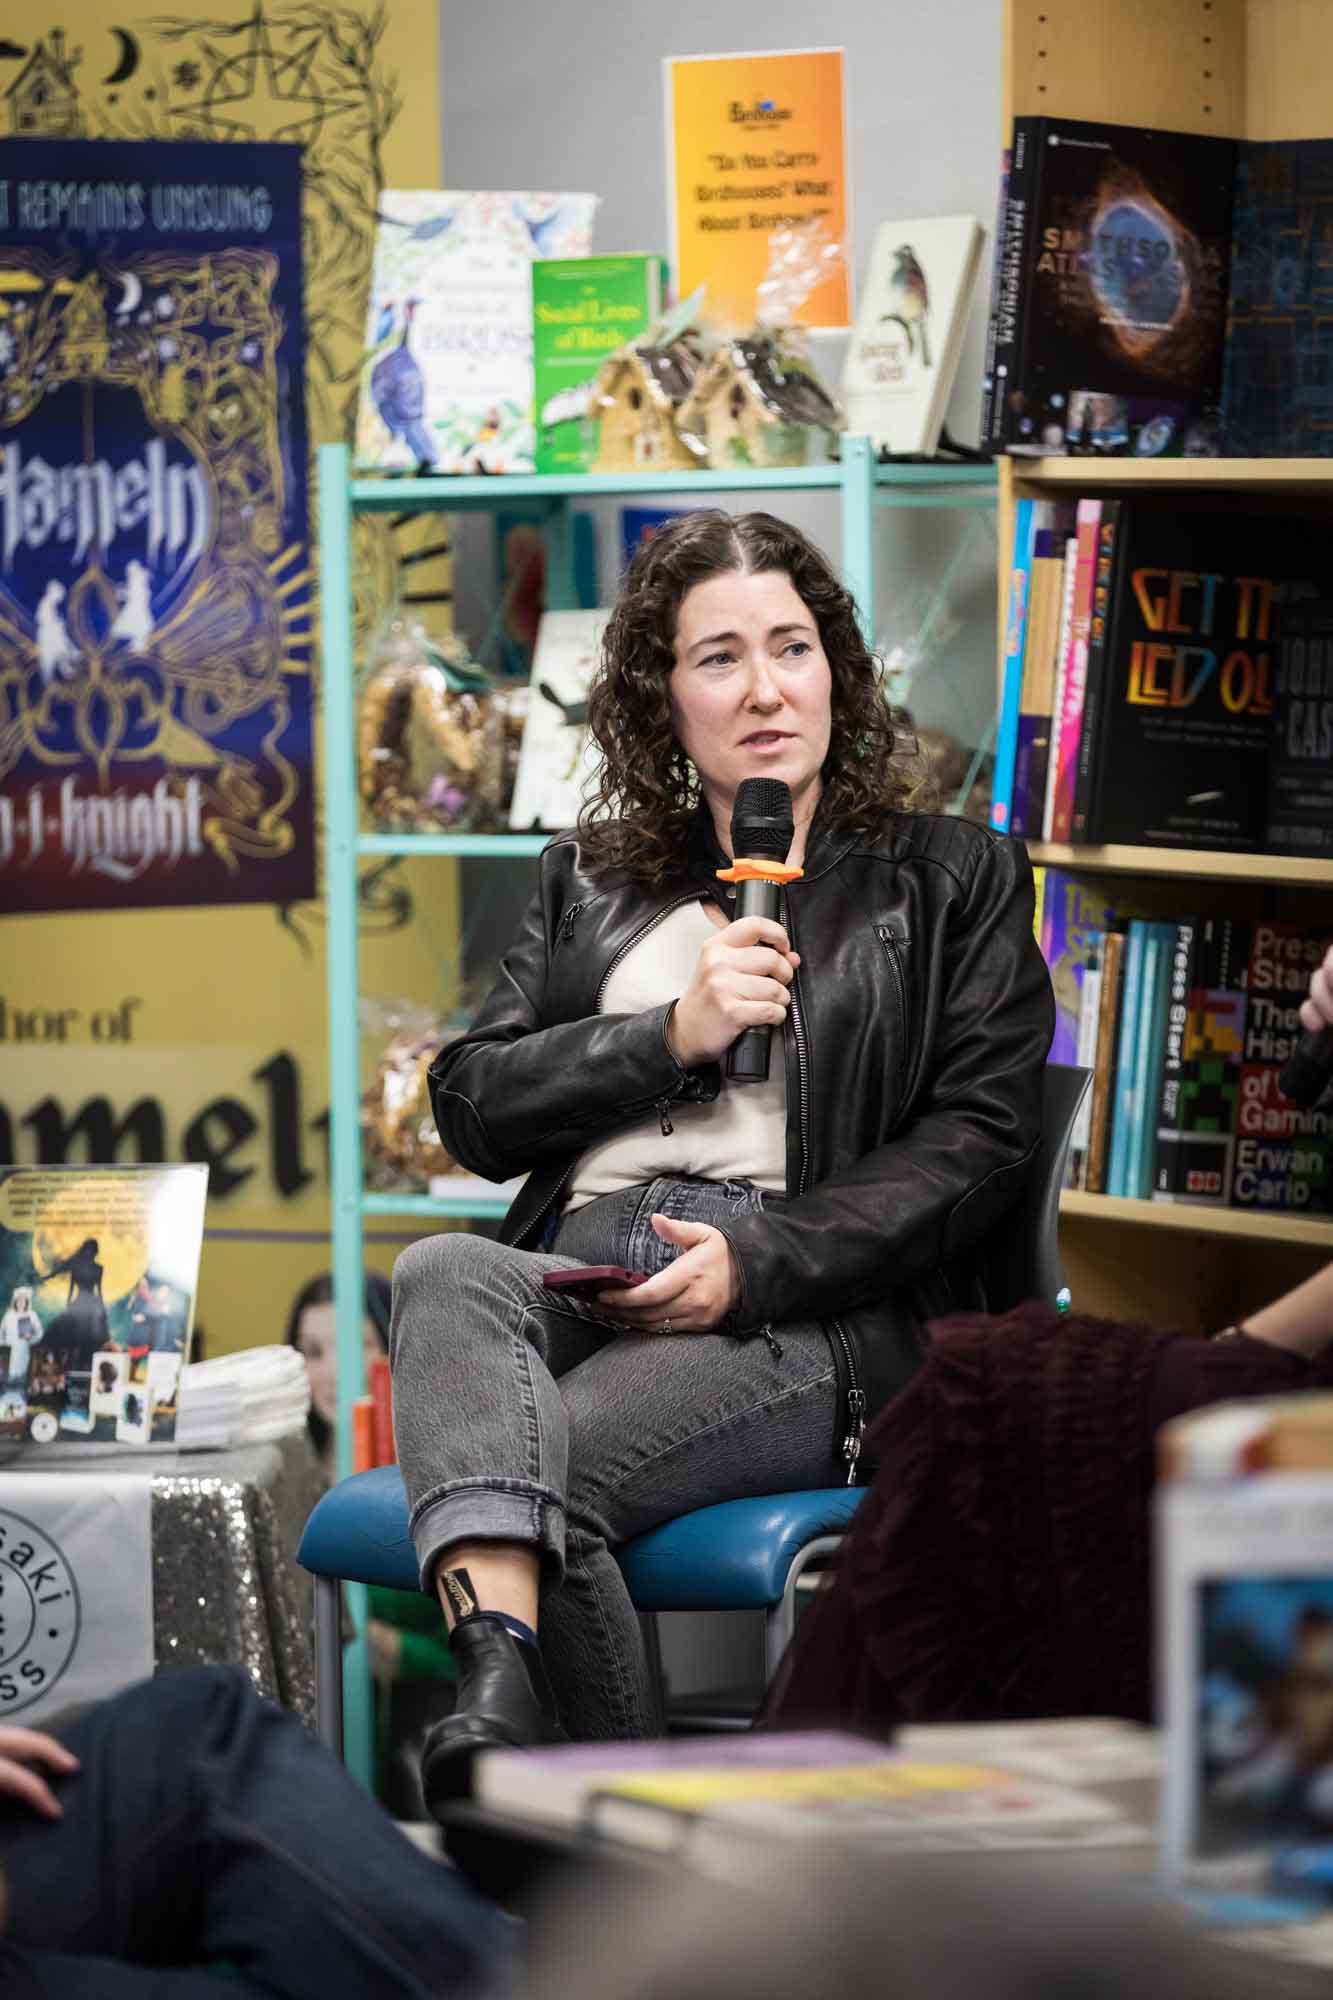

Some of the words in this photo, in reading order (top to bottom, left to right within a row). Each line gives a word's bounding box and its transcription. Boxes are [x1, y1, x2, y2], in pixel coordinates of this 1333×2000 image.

[1131, 567, 1223, 636] GET
[1127, 640, 1218, 707] LED
[1171, 925, 1194, 1000] Press
[1255, 928, 1322, 961] Pres
[1253, 960, 1311, 990] Star
[90, 995, 144, 1043] of
[1165, 1004, 1187, 1071] Start
[1250, 997, 1300, 1031] The
[1242, 1069, 1274, 1100] of
[0, 1049, 331, 1200] mel
[1236, 1139, 1324, 1173] Erwan
